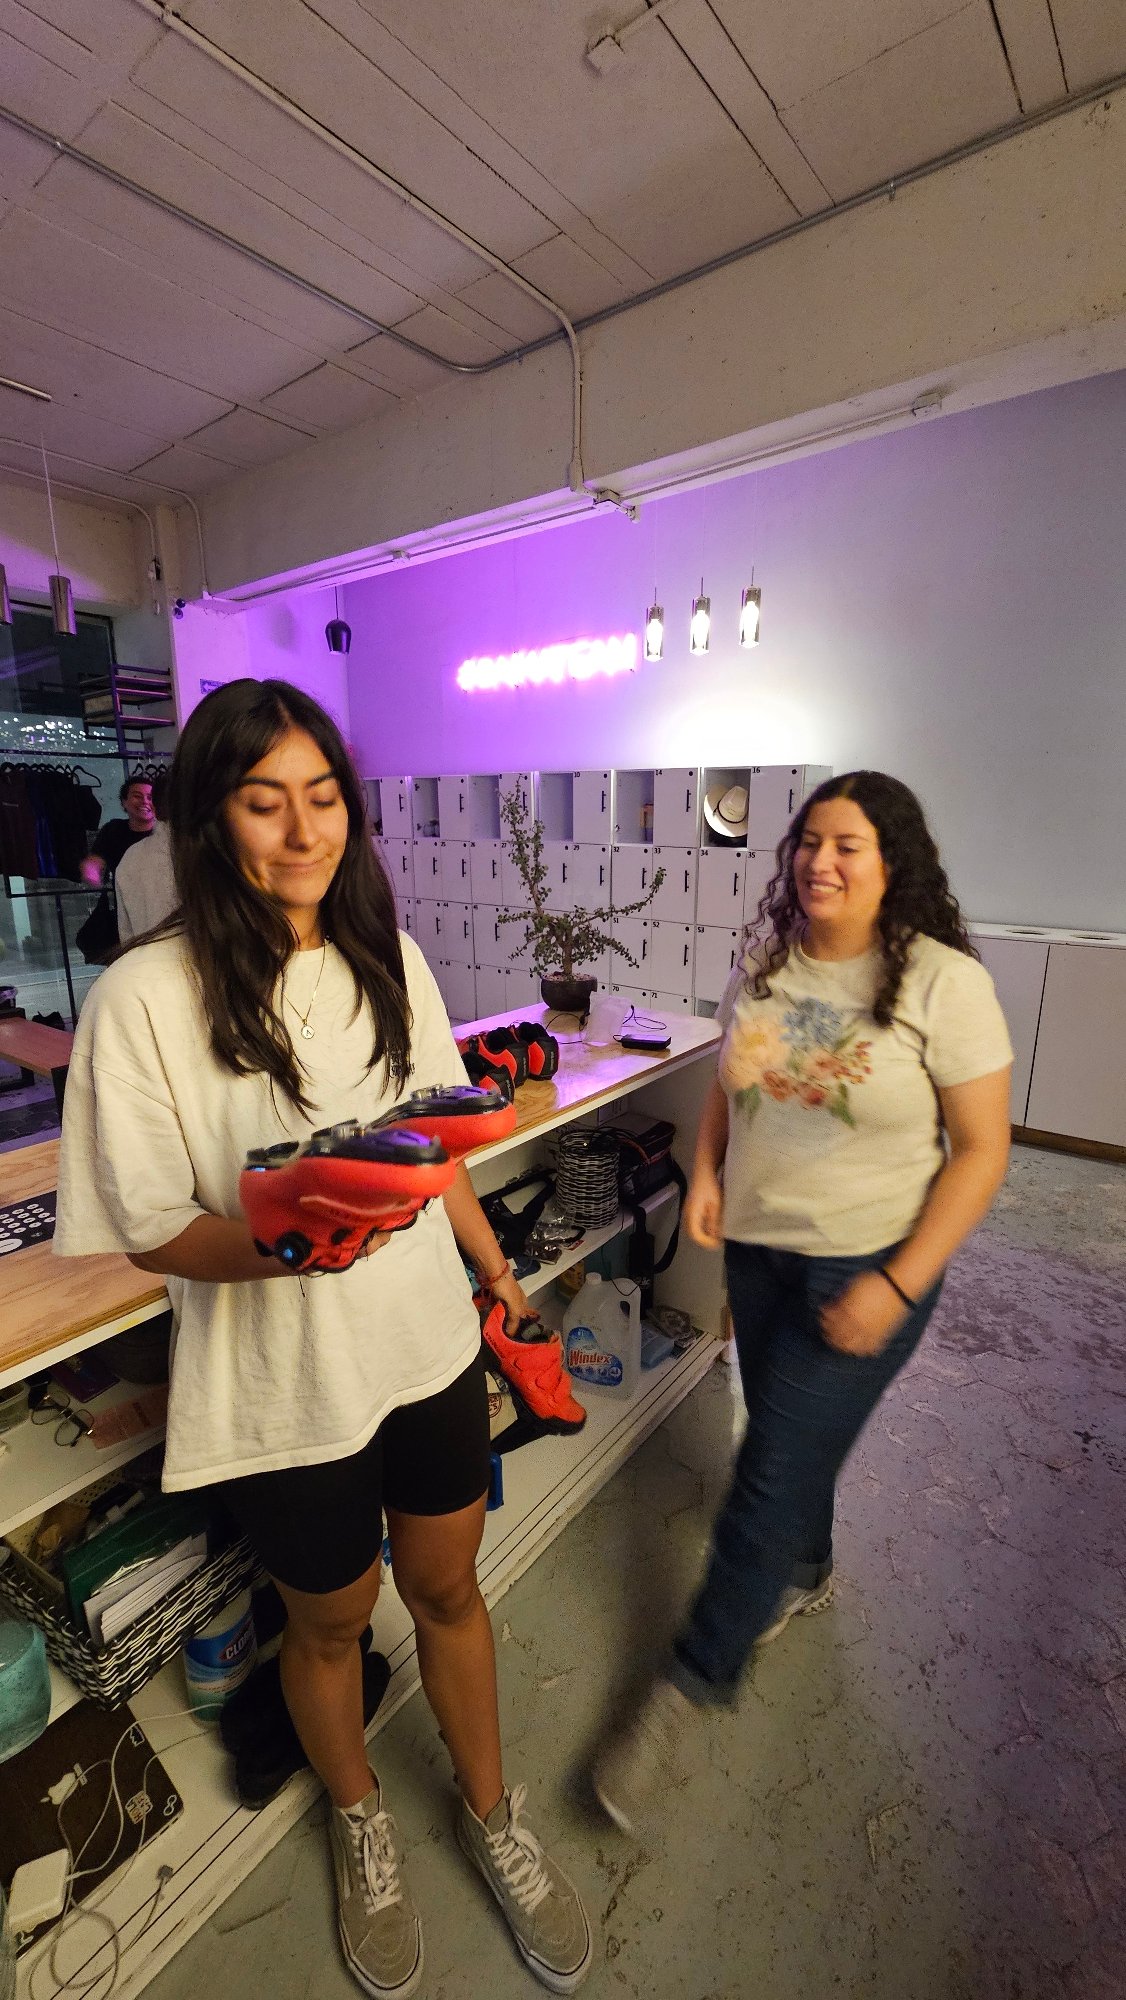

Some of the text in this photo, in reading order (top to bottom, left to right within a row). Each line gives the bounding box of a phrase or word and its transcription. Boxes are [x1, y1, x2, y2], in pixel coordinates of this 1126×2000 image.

[700, 849, 709, 857] 34
[747, 851, 756, 859] 35
[570, 1350, 610, 1366] Windex
